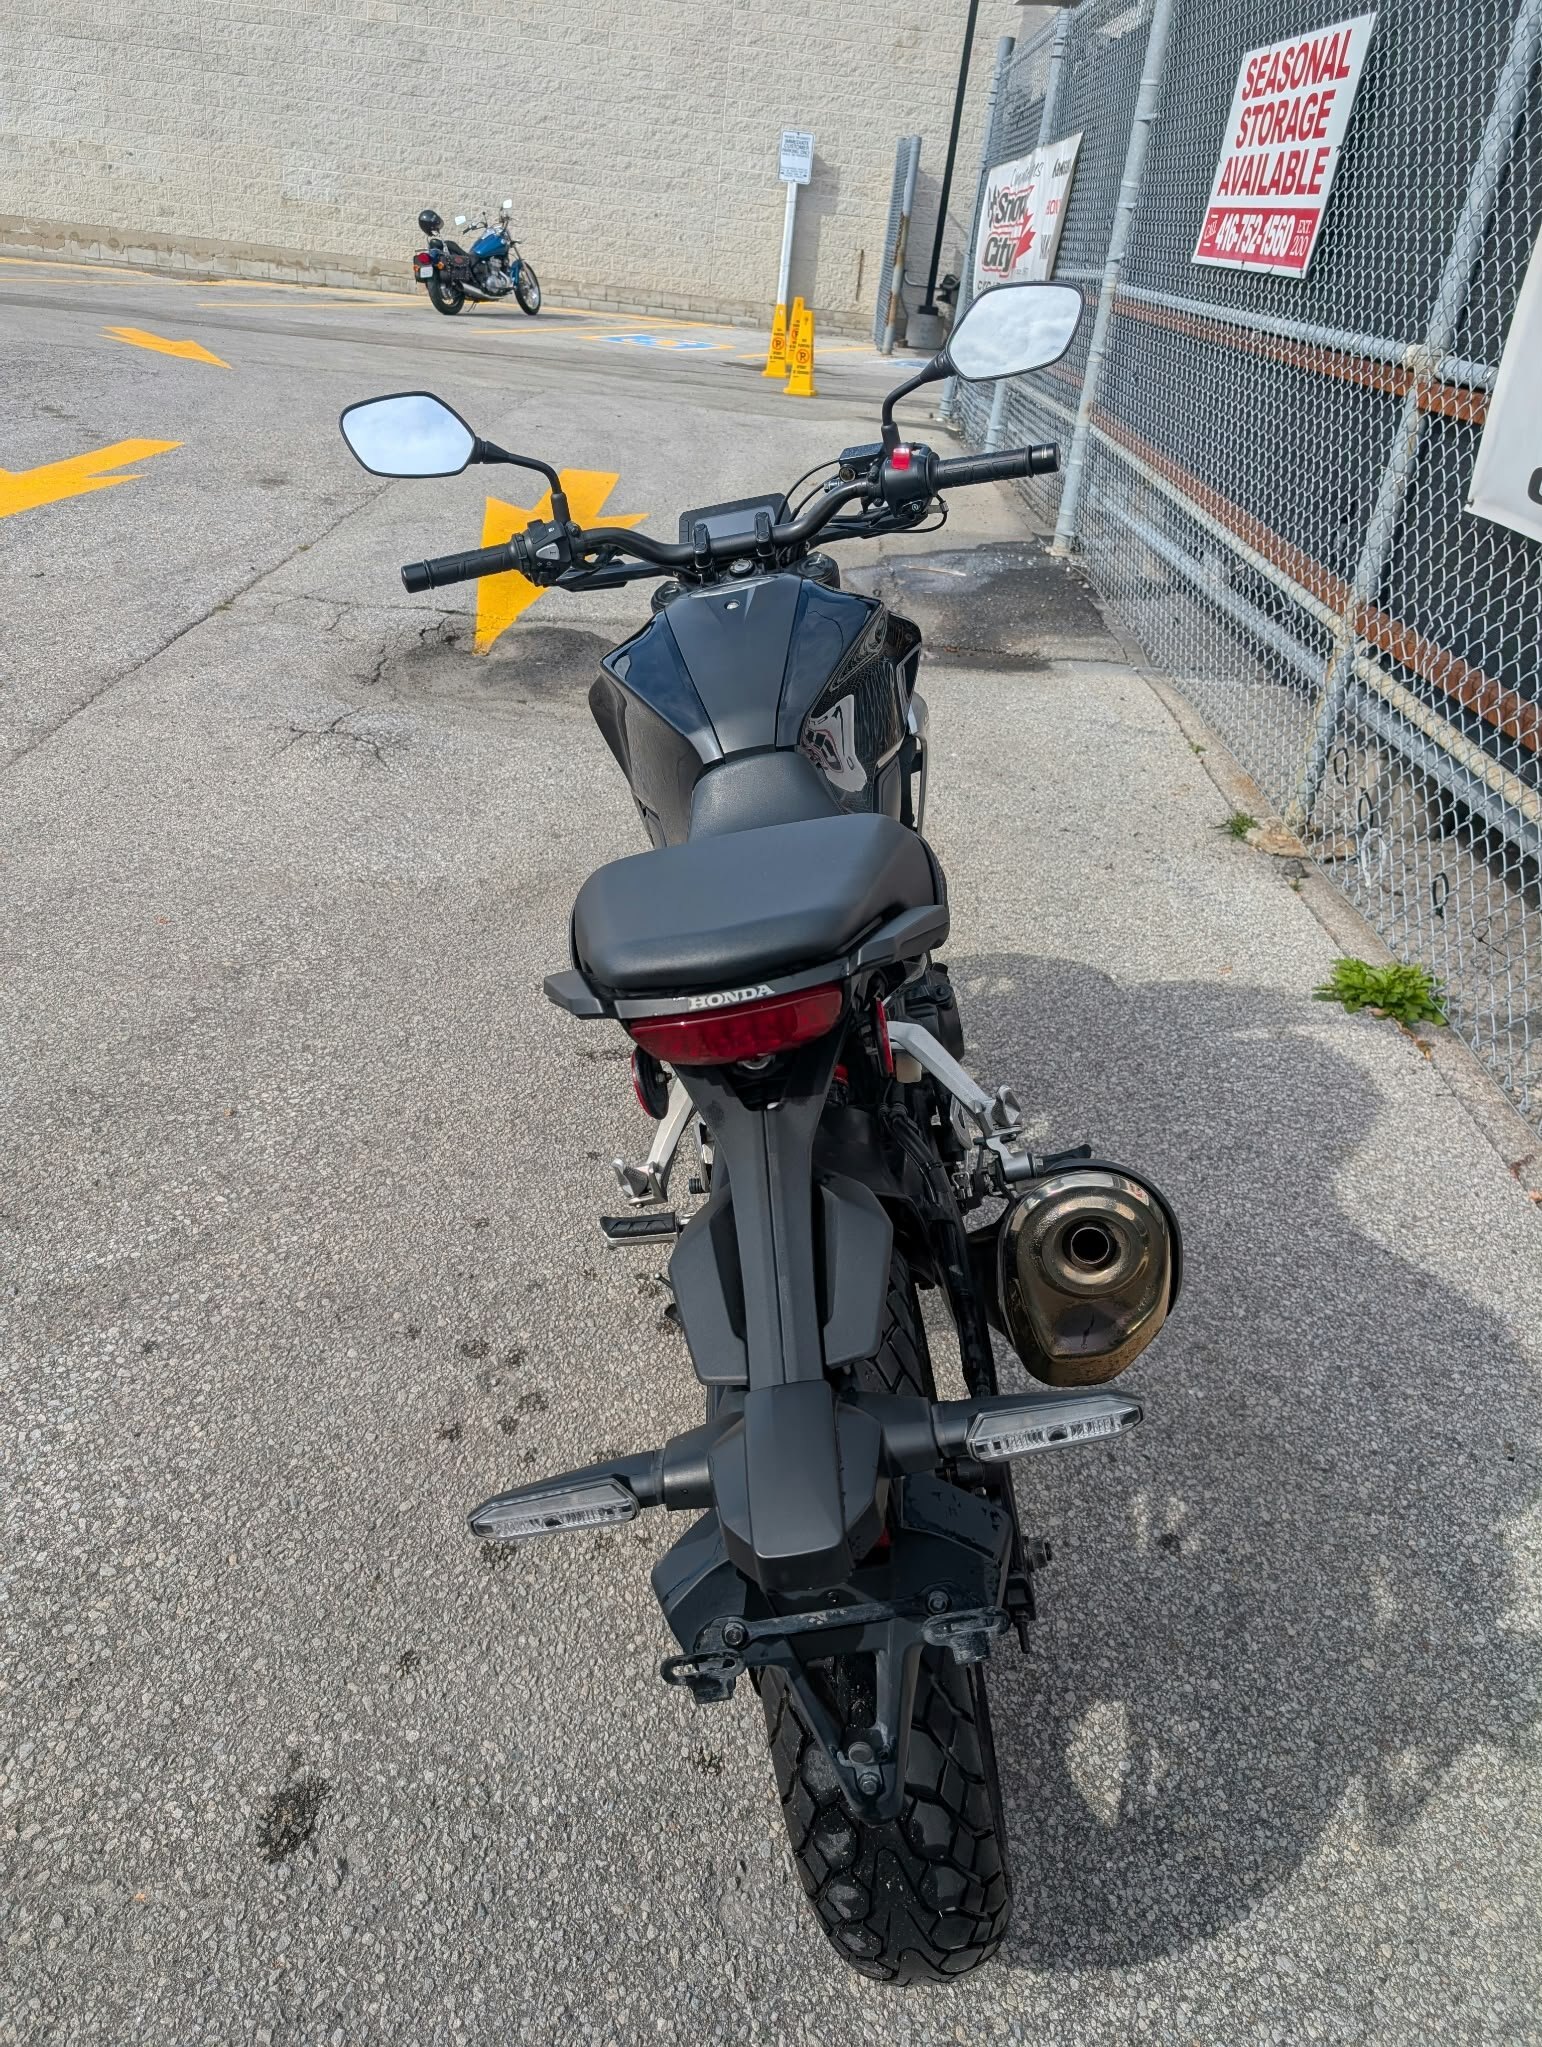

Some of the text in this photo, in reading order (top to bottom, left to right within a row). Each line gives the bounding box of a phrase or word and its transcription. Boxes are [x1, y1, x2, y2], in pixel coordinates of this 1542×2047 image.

[1241, 28, 1353, 101] SEASONAL
[1235, 89, 1336, 149] STORAGE
[1217, 147, 1331, 197] AVAILABLE
[1215, 213, 1296, 258] 416-752-1560
[1289, 236, 1309, 257] 200
[1297, 219, 1312, 234] EXT.
[983, 236, 1017, 272] City
[689, 984, 775, 1011] HONDA
